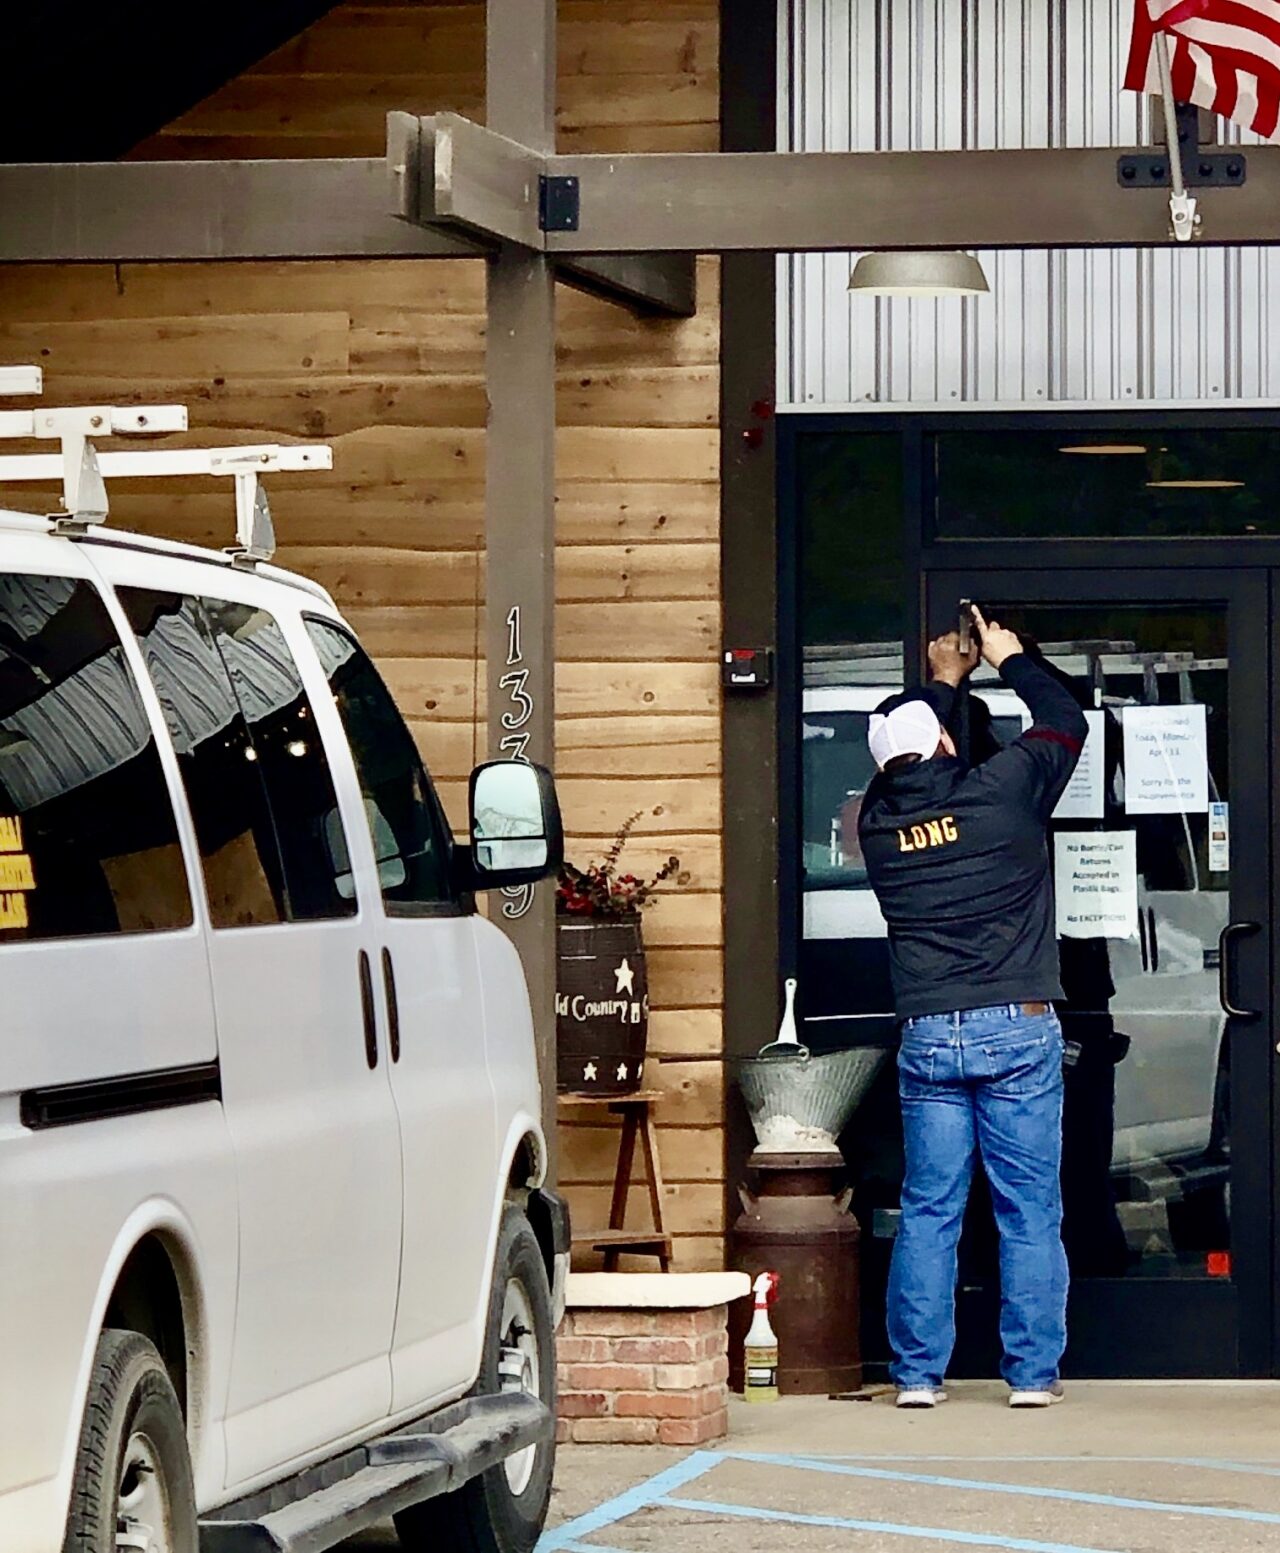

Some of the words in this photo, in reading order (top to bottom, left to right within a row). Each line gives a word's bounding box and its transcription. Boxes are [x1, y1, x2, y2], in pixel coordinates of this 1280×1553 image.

[897, 816, 958, 852] LONG
[1067, 844, 1079, 852] No
[1072, 871, 1110, 879] Accepted
[1073, 885, 1098, 893] Plastic
[555, 993, 570, 1016] ld
[572, 995, 628, 1023] Country
